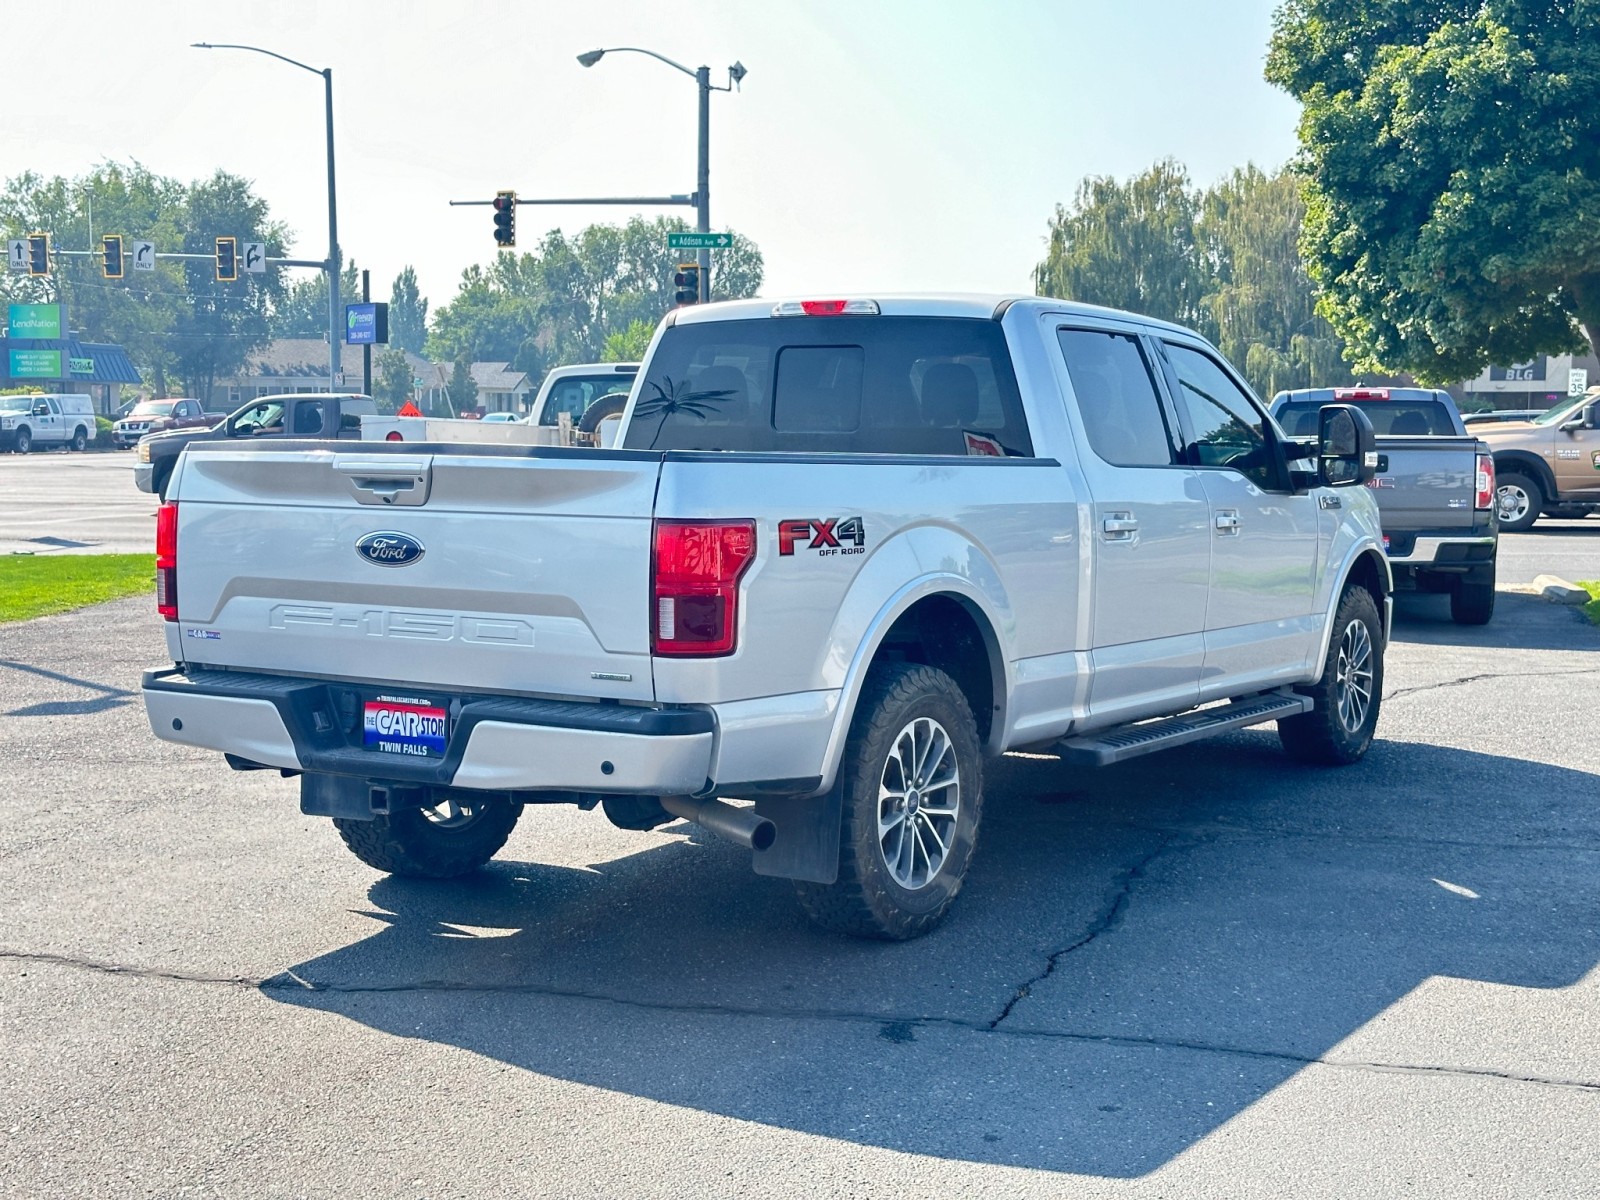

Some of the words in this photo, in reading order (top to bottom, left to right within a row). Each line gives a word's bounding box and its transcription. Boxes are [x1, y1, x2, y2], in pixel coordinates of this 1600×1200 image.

[679, 236, 702, 245] Addison
[11, 260, 29, 268] ONLY
[12, 319, 57, 328] LendNation
[353, 312, 374, 325] Freeway
[1505, 369, 1533, 380] BLG
[1570, 383, 1584, 393] 35
[1366, 477, 1395, 489] MC
[778, 516, 865, 557] FX4
[370, 537, 407, 559] Ford
[819, 549, 838, 557] OFF
[841, 547, 865, 555] ROAD
[269, 603, 535, 648] F-150
[365, 716, 375, 726] THE
[375, 708, 420, 738] CAR
[421, 716, 445, 737] STOR
[379, 741, 401, 753] TWIN
[403, 744, 427, 756] FALLS
